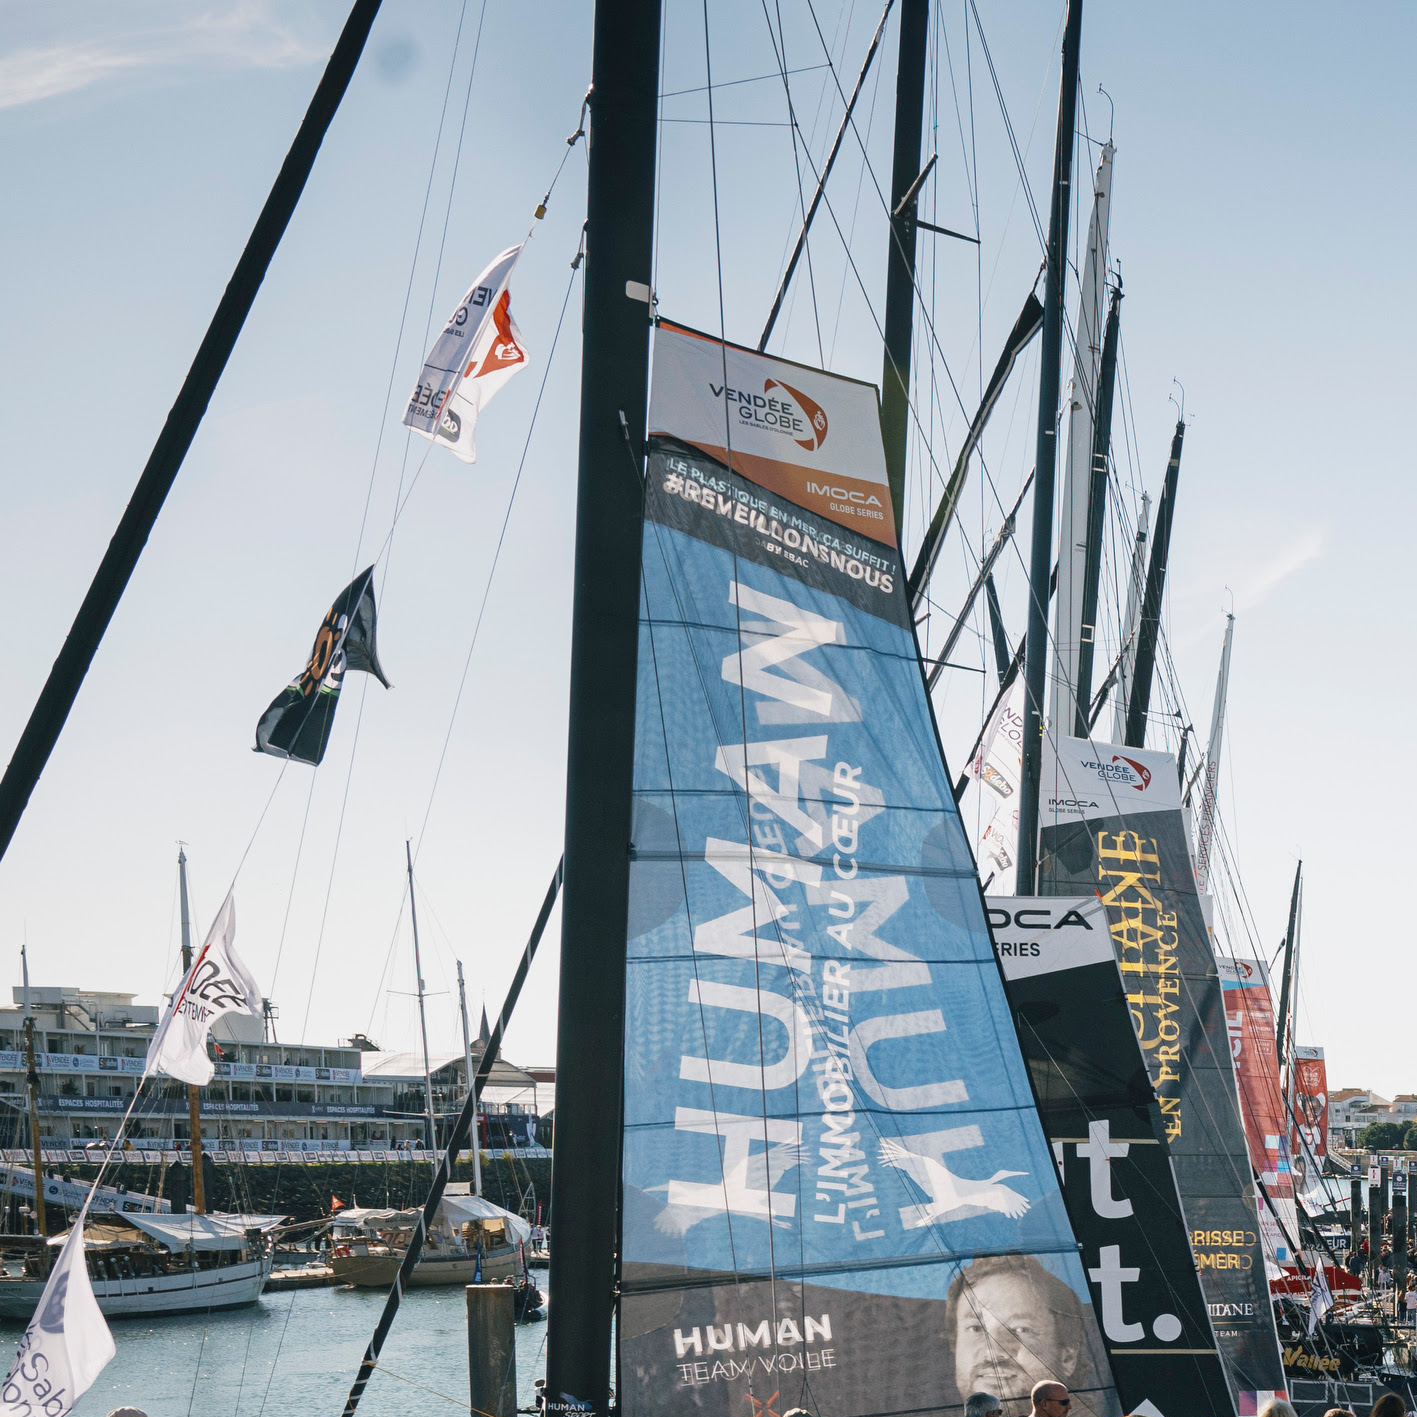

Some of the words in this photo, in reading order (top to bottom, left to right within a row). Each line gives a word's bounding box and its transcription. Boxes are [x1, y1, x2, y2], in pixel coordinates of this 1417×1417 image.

[709, 383, 794, 416] VENDÉE
[739, 405, 804, 433] GLOBE
[806, 481, 882, 507] IMOCA
[669, 457, 687, 473] LE
[690, 467, 767, 513] PLASTIQUE
[771, 506, 788, 522] EN
[845, 543, 889, 571] SUFFIT
[829, 502, 855, 515] GLOBE
[856, 505, 884, 520] SERIES
[1081, 760, 1130, 775] VENDÉE
[1097, 770, 1137, 782] GLOBE
[1048, 798, 1100, 809] IMOCA
[667, 581, 845, 1220] HUMAN
[1156, 910, 1182, 1082] PROVENCE
[58, 1098, 84, 1107] ESPACES
[84, 1097, 124, 1108] HOSPITALITÉS
[813, 957, 853, 1223] L'IMMOBILIER
[203, 1102, 225, 1111] ESPACES
[225, 1101, 259, 1112] HOSPITALITÉS
[326, 1105, 345, 1114] ESPACES
[346, 1105, 375, 1114] HOSPITALITÉS
[674, 1314, 833, 1354] HUMAN
[676, 1358, 748, 1383] TEAM
[758, 1348, 837, 1376] VOILE
[548, 1402, 585, 1412] HUMAN
